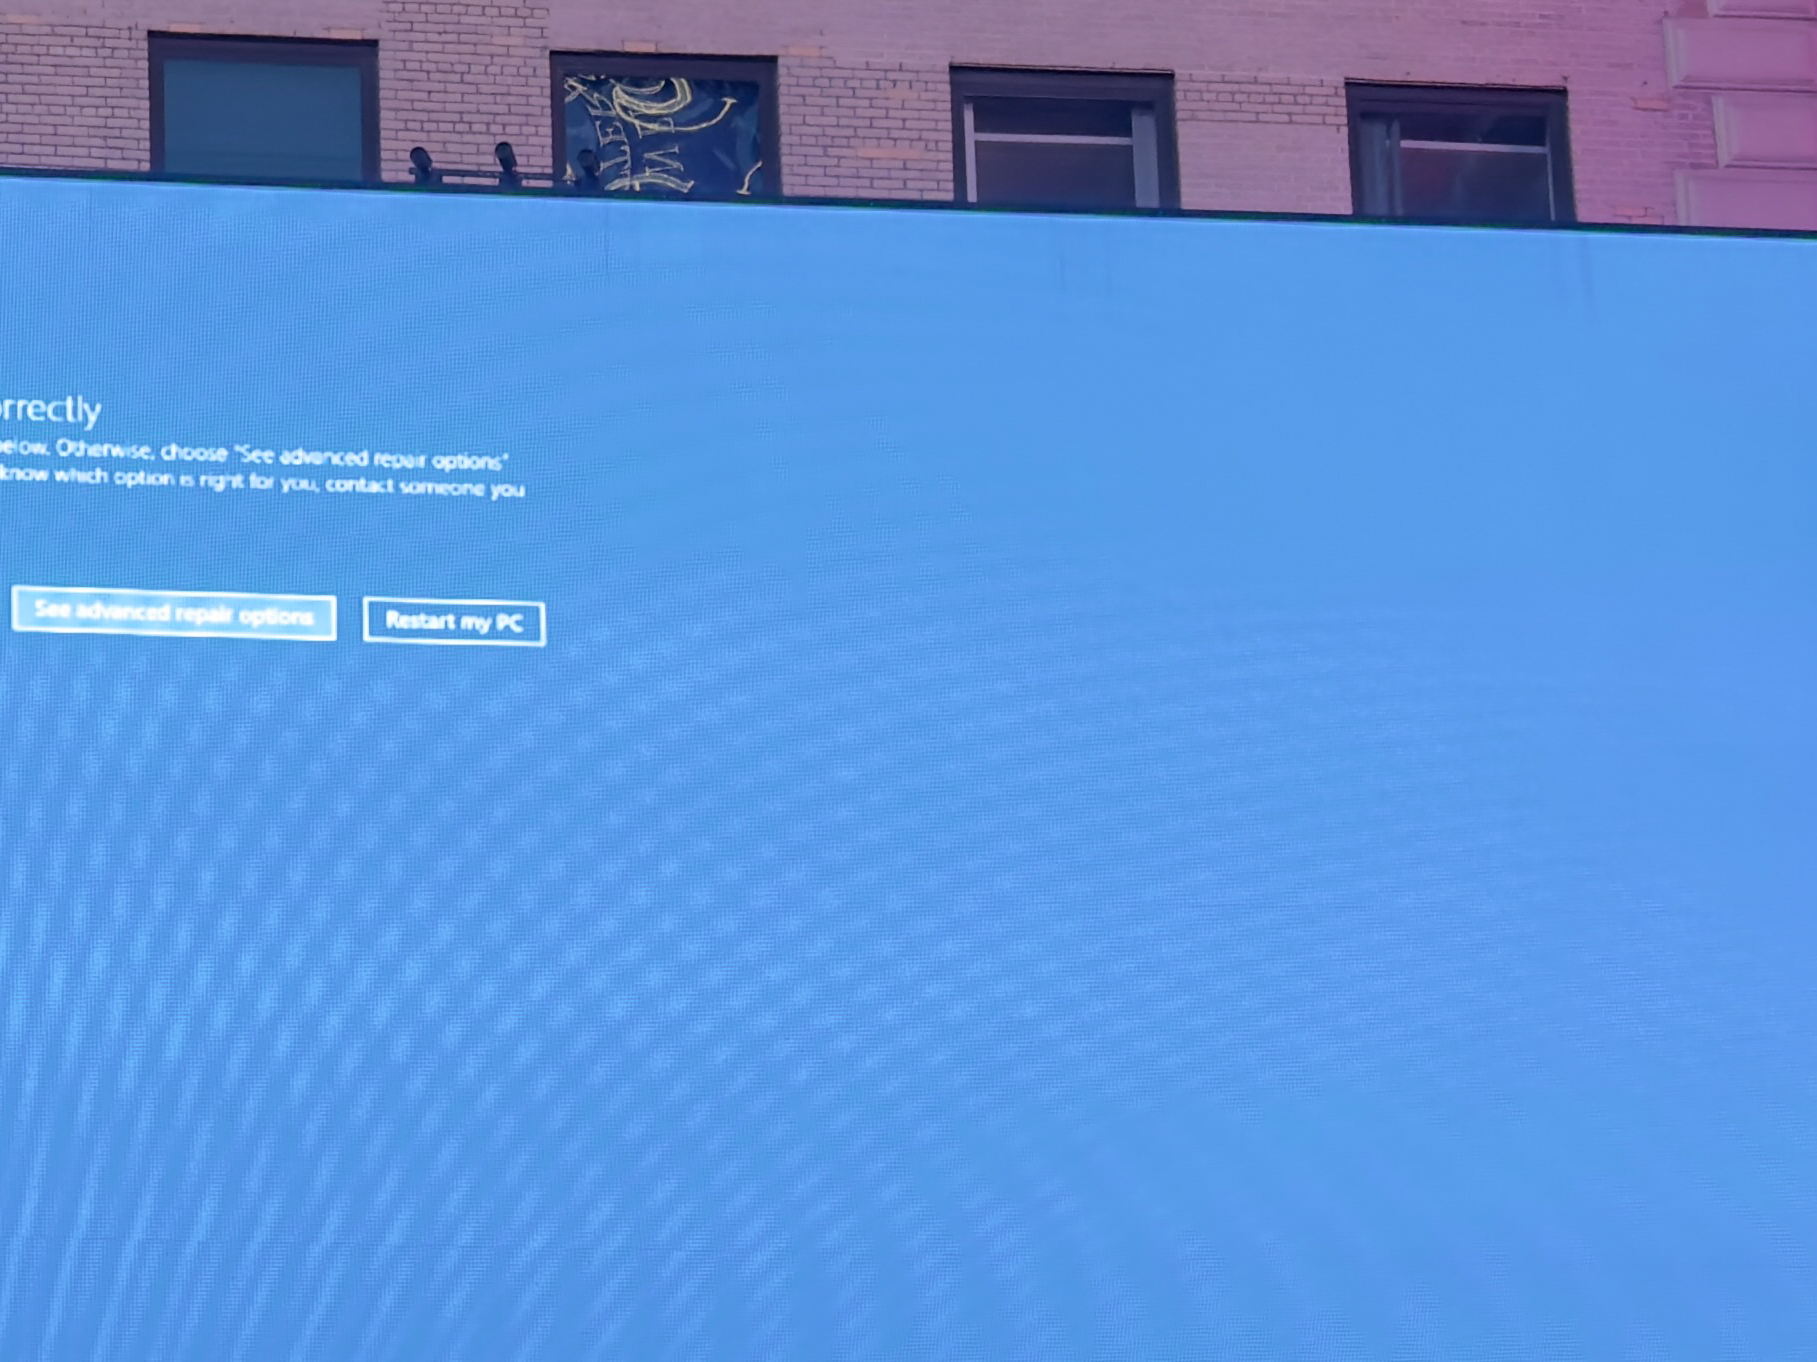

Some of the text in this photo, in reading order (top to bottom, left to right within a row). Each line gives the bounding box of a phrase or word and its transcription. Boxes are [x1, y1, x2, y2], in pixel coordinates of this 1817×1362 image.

[55, 437, 156, 462] Otherwise,
[160, 442, 229, 463] choose
[279, 447, 370, 467] advanced
[373, 452, 426, 471] repair
[53, 468, 109, 485] which
[113, 469, 176, 489] option
[179, 473, 196, 487] is
[199, 473, 245, 493] right
[249, 472, 275, 490] for
[325, 476, 395, 494] contact
[398, 480, 486, 498] someone
[490, 483, 526, 501] you
[34, 600, 315, 628] See advanced repair options
[384, 610, 524, 636] Restart my PC
